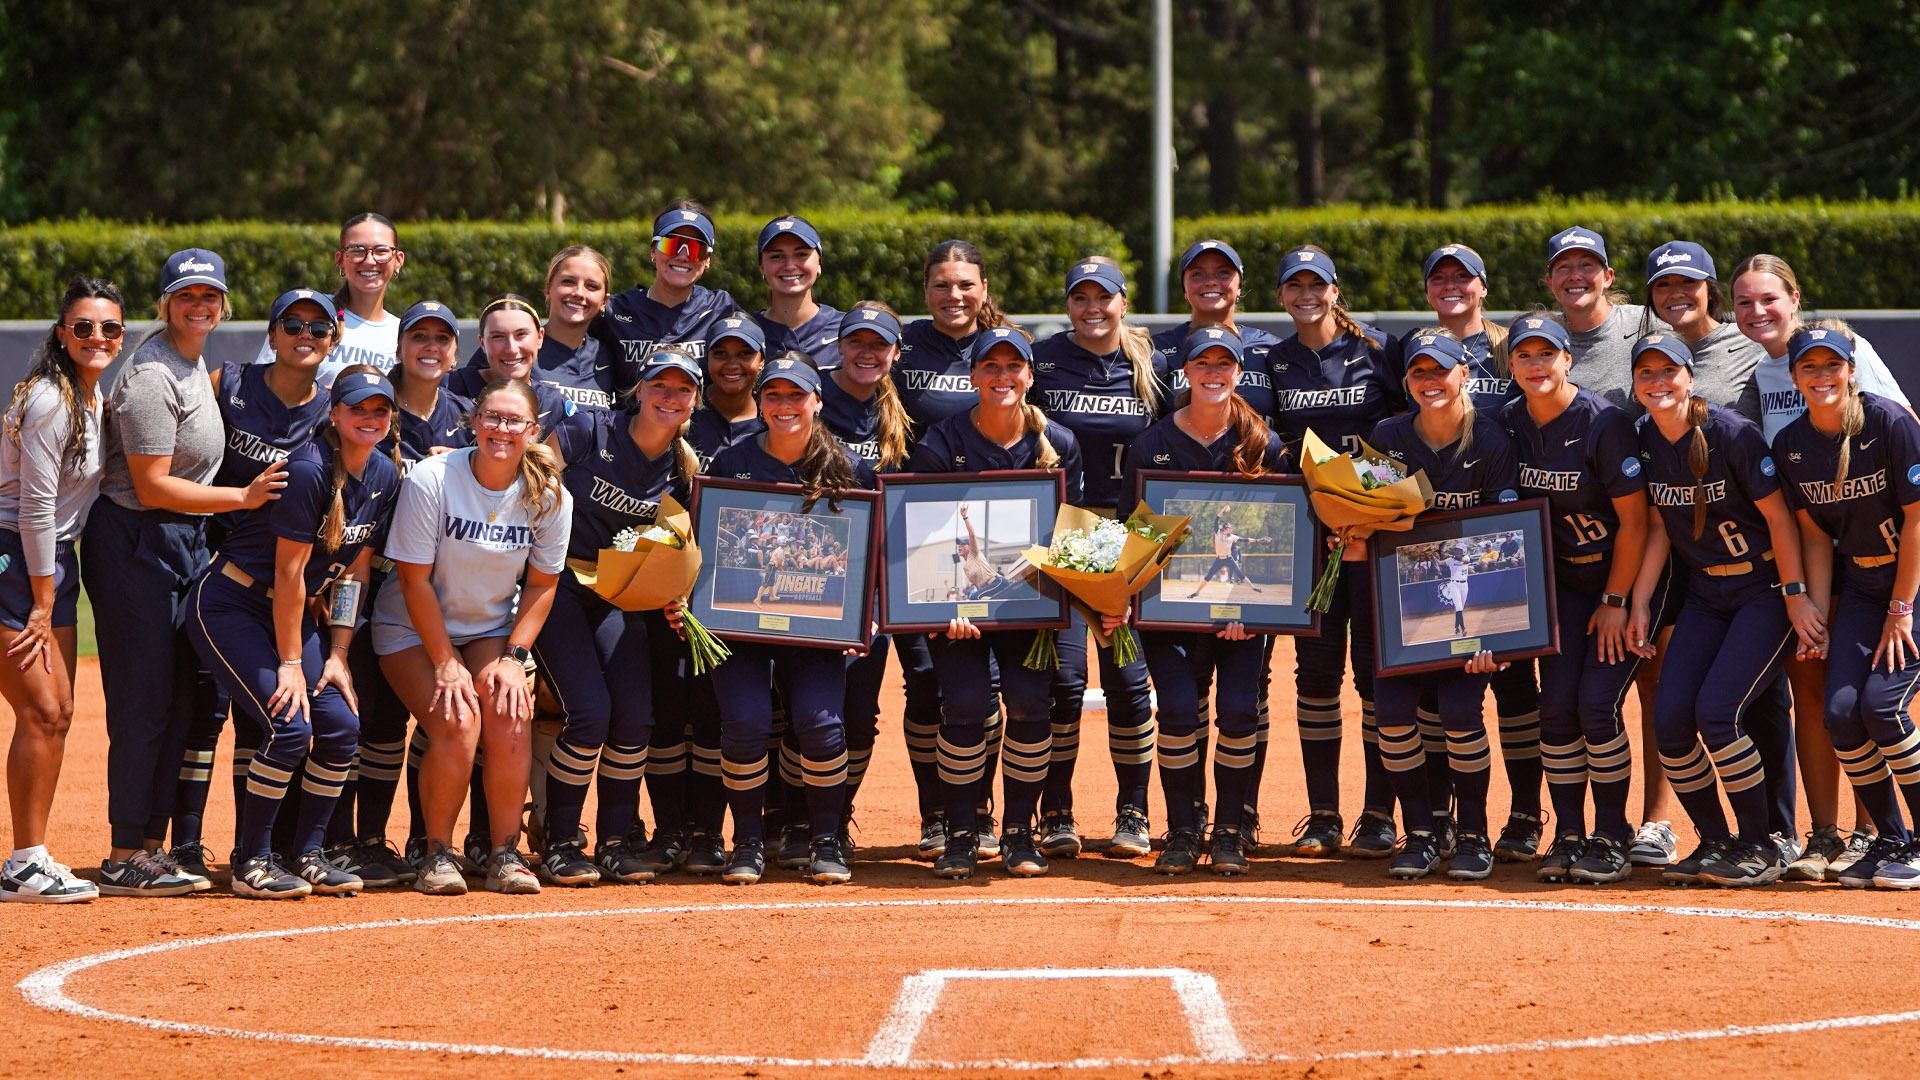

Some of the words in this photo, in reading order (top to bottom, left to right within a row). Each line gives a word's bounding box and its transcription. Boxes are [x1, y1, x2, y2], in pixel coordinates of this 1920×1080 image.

[1038, 362, 1056, 370] SAC
[1044, 390, 1145, 416] WINGATE
[1278, 386, 1366, 411] WINGATE
[1110, 443, 1125, 479] 1
[1156, 454, 1171, 462] SAC
[1563, 513, 1608, 546] 15
[1718, 520, 1749, 557] 6
[315, 562, 346, 595] 2
